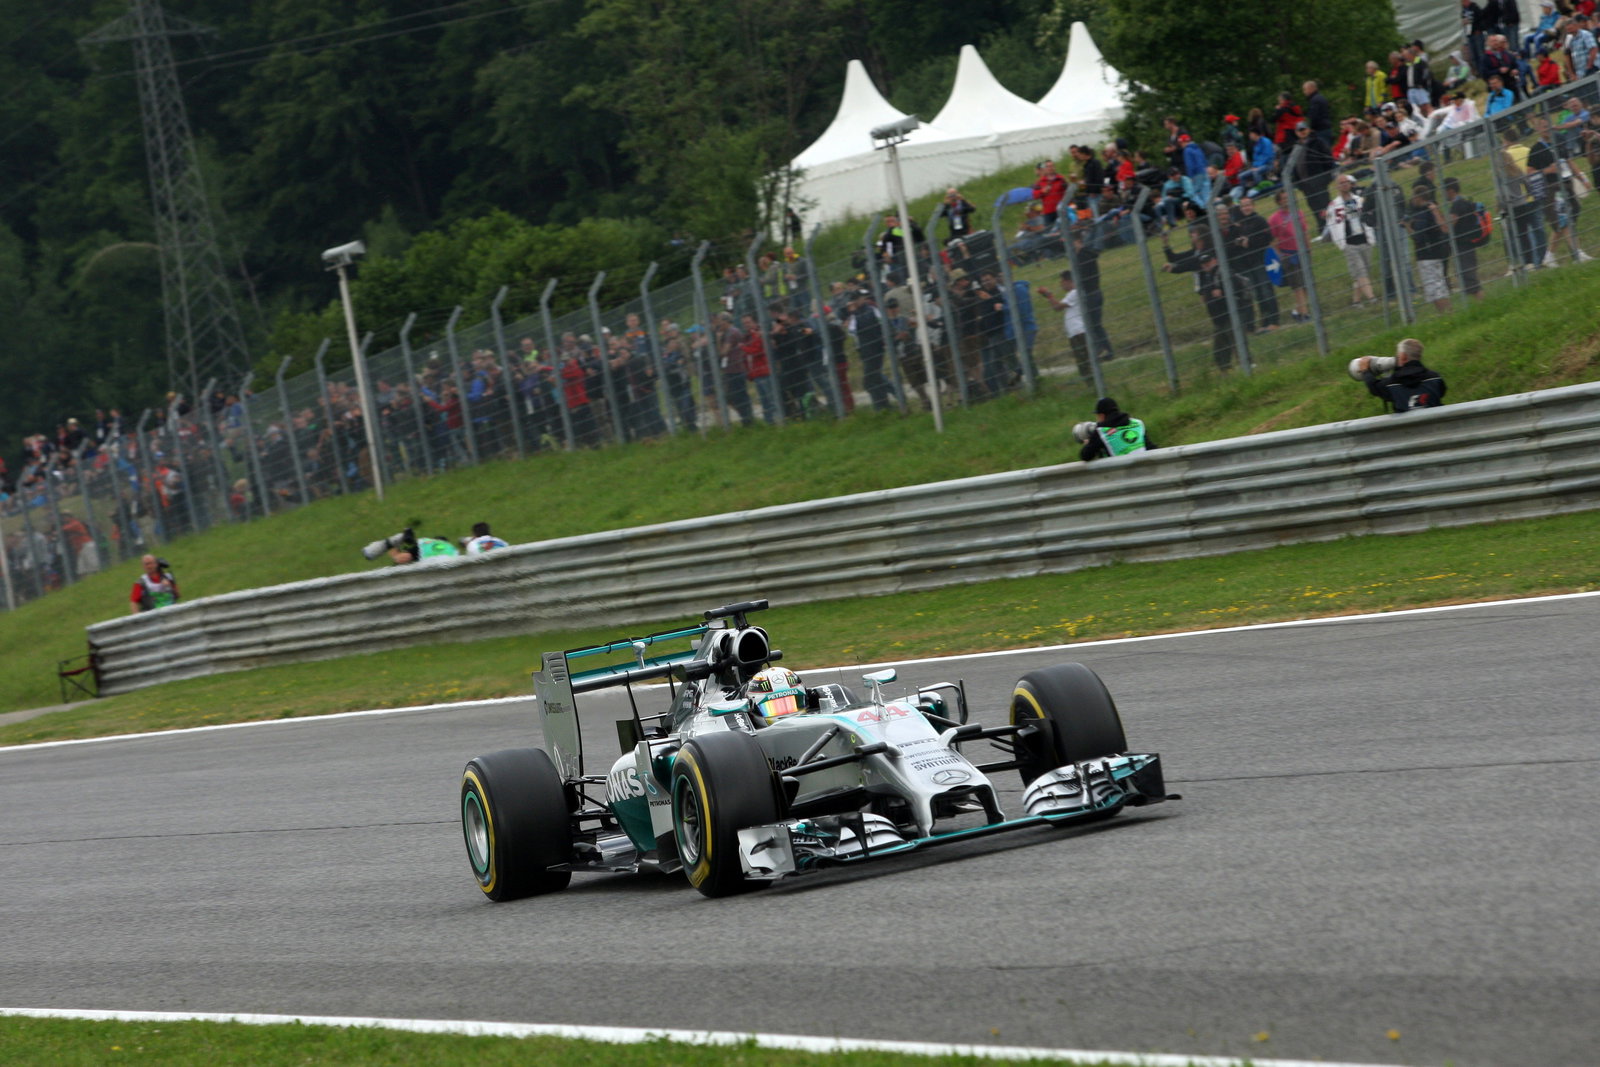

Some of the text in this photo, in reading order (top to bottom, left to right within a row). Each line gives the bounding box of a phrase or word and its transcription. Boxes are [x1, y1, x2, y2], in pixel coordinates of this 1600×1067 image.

[767, 689, 799, 700] PETRONAS
[857, 705, 910, 722] 44
[914, 757, 961, 772] SYNTIUM
